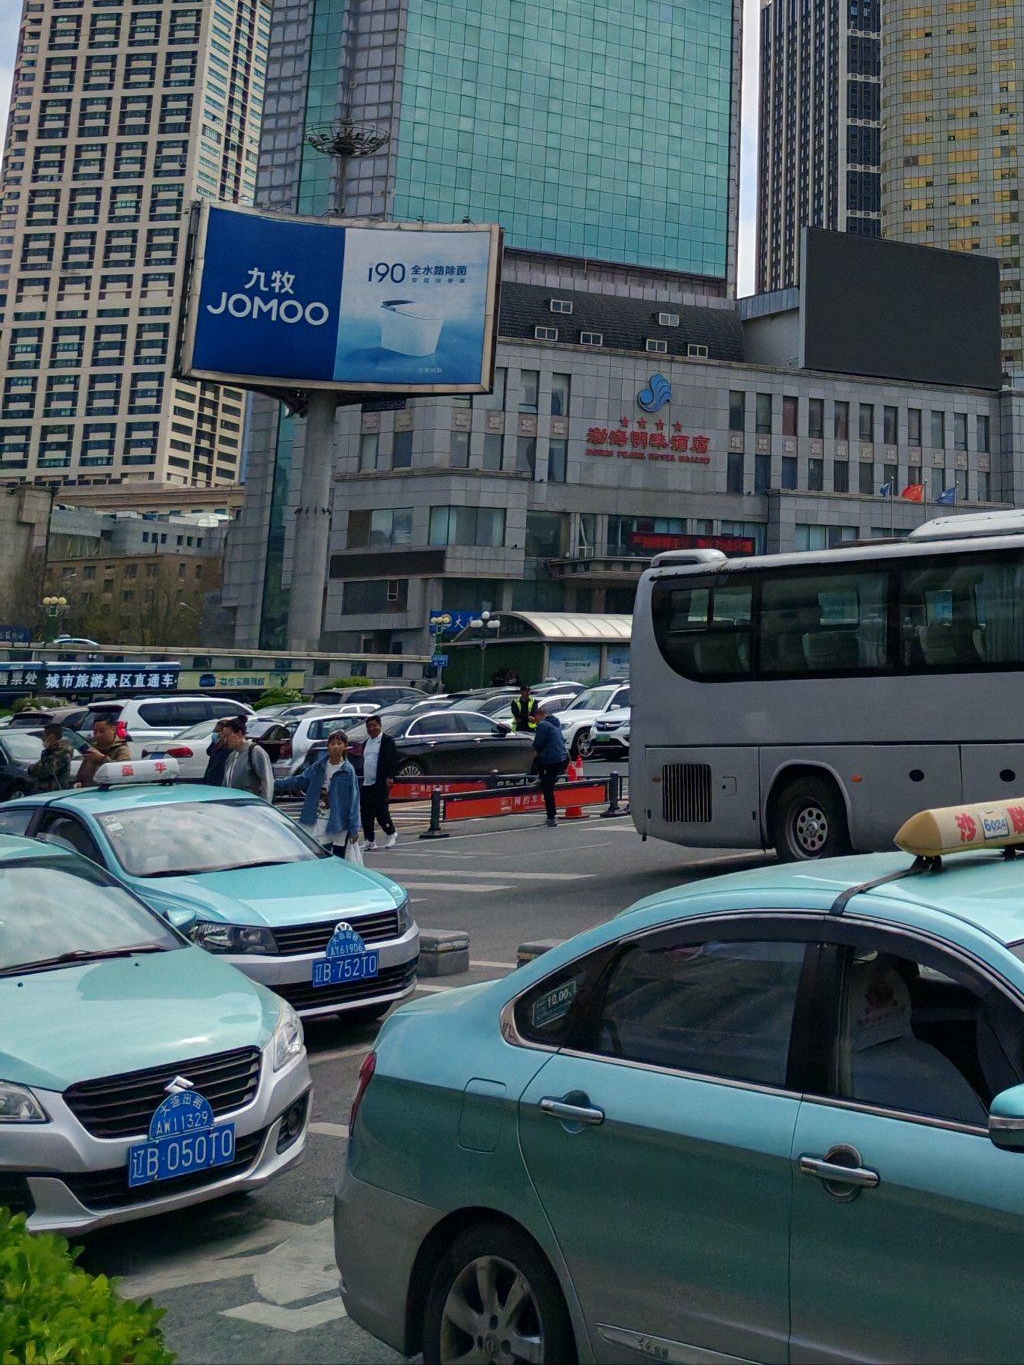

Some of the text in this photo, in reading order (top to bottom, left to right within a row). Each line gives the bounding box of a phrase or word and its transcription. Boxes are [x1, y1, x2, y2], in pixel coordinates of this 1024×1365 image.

[244, 267, 296, 295] 九牧
[411, 265, 467, 276] 全水路除菌
[206, 291, 329, 326] JOMOO
[46, 673, 174, 689] 城市旅游景区直通车
[984, 818, 1007, 832] 6024
[159, 1093, 203, 1117] 大连出租
[155, 1111, 208, 1135] AW11329
